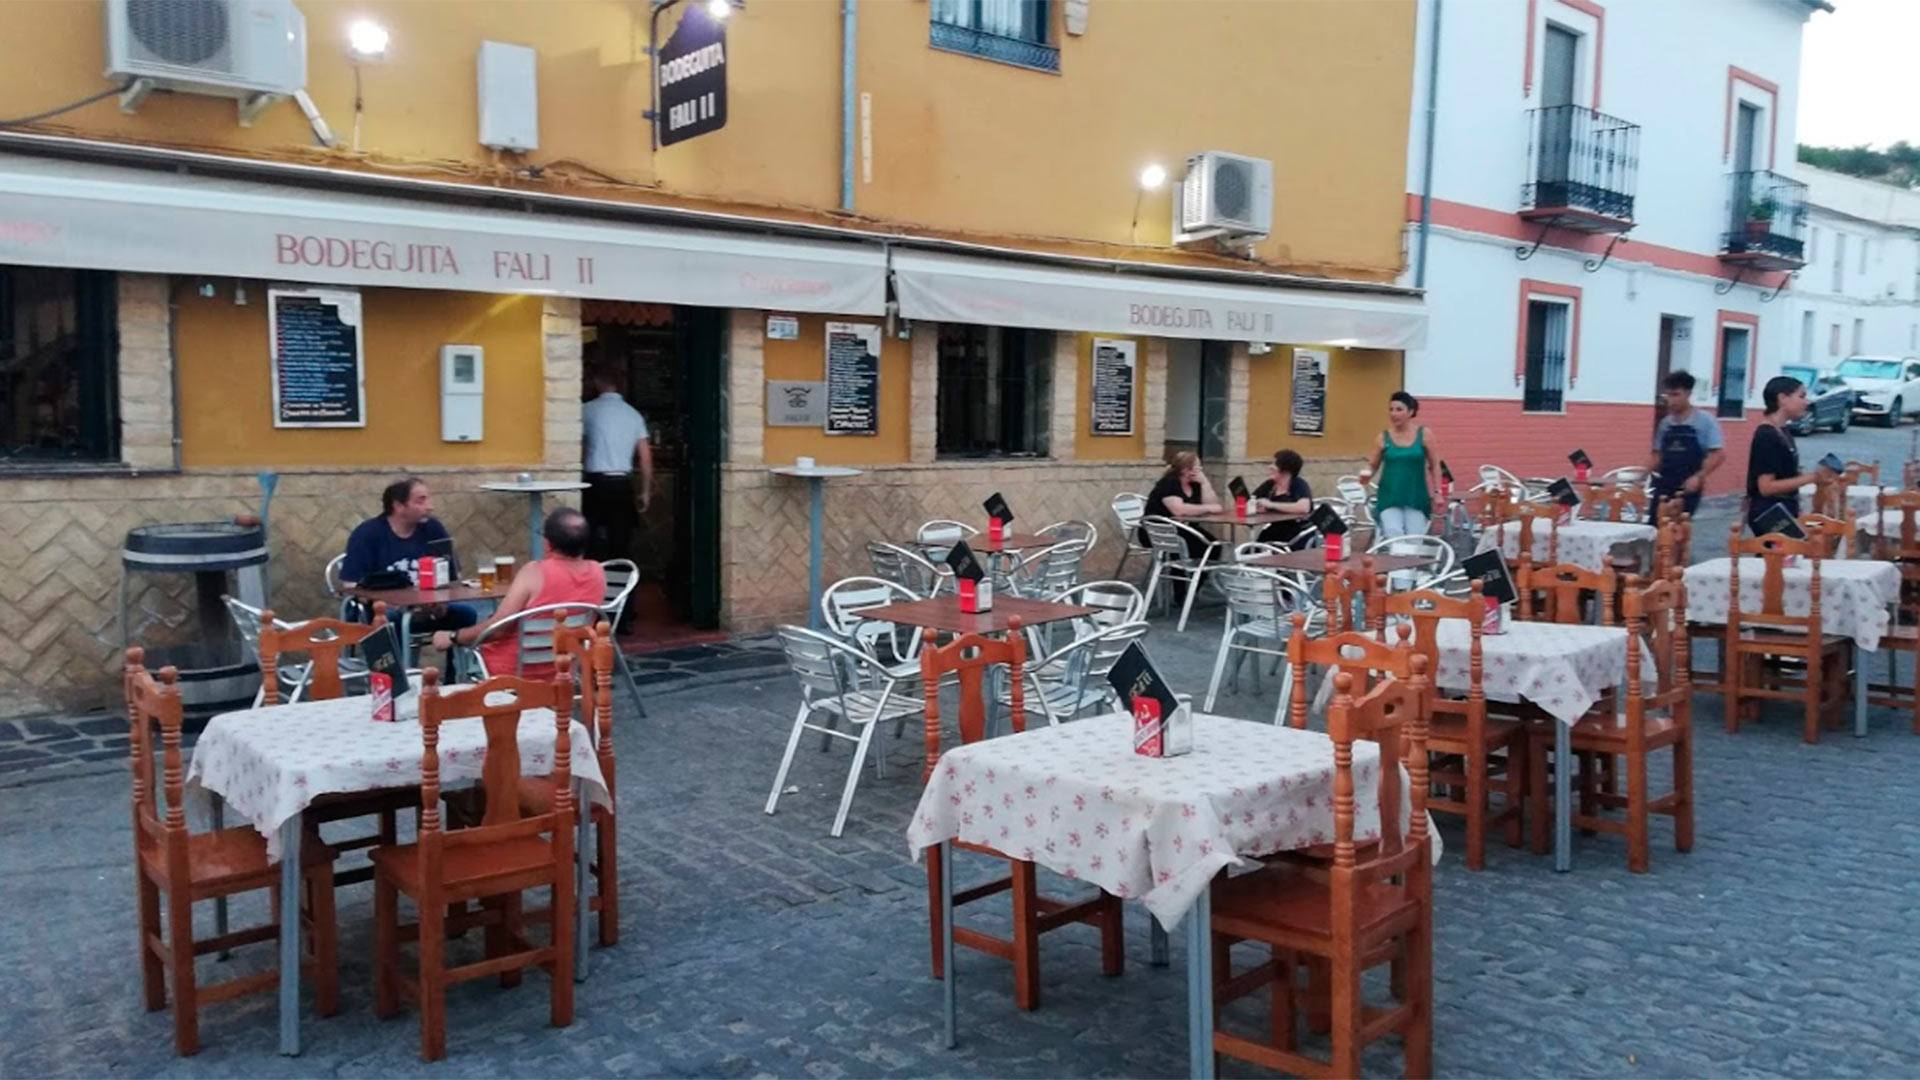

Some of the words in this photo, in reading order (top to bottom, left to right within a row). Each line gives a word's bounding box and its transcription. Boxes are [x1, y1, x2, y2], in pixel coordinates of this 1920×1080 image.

[661, 42, 725, 88] BODEGUITA
[670, 99, 697, 131] FALI
[275, 233, 460, 275] BODEGUITA
[493, 250, 552, 281] FALI
[577, 257, 595, 284] II
[1129, 303, 1214, 329] BODEGUITA
[1226, 310, 1256, 332] FALI
